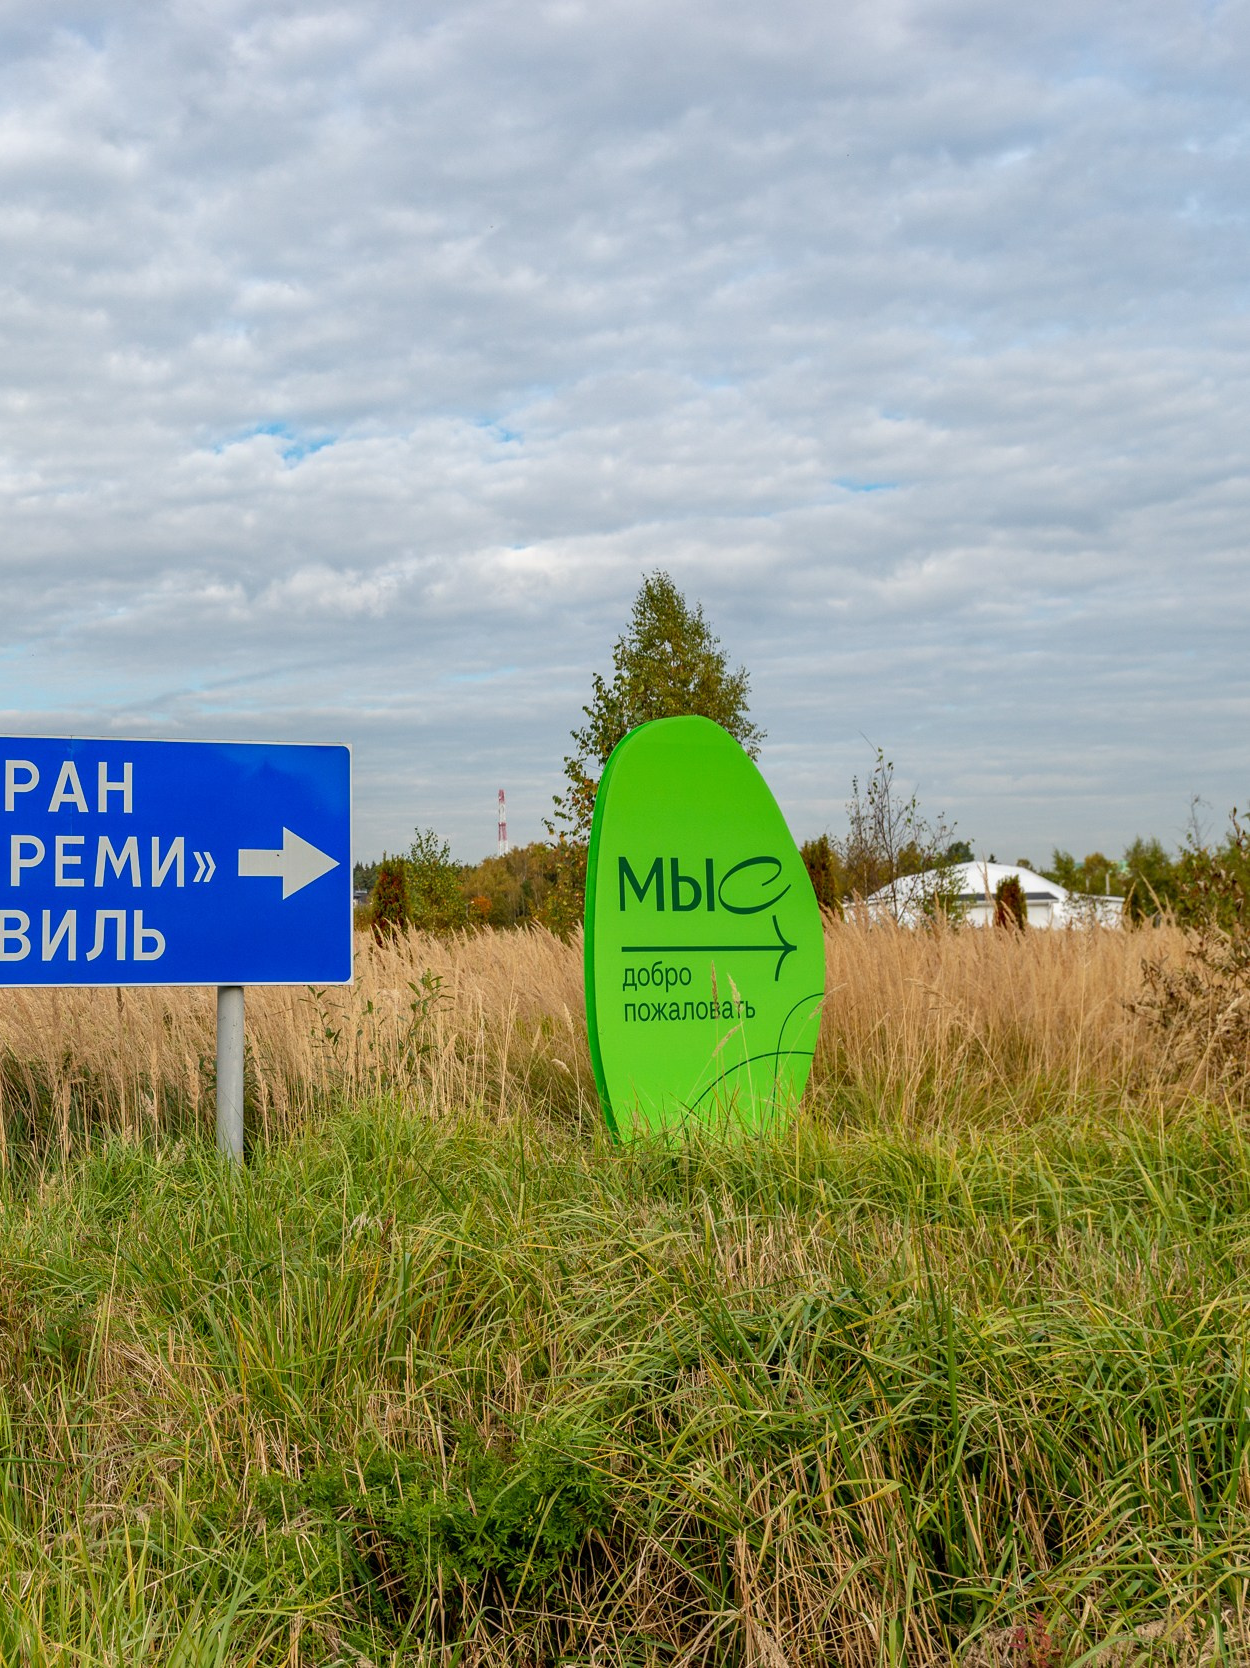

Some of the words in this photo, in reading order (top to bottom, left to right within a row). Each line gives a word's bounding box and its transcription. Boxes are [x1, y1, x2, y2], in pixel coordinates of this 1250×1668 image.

[11, 834, 217, 888] РЕМИ»
[618, 856, 791, 915] МЫС
[622, 961, 692, 992] добро
[624, 999, 756, 1022] пожаловать
